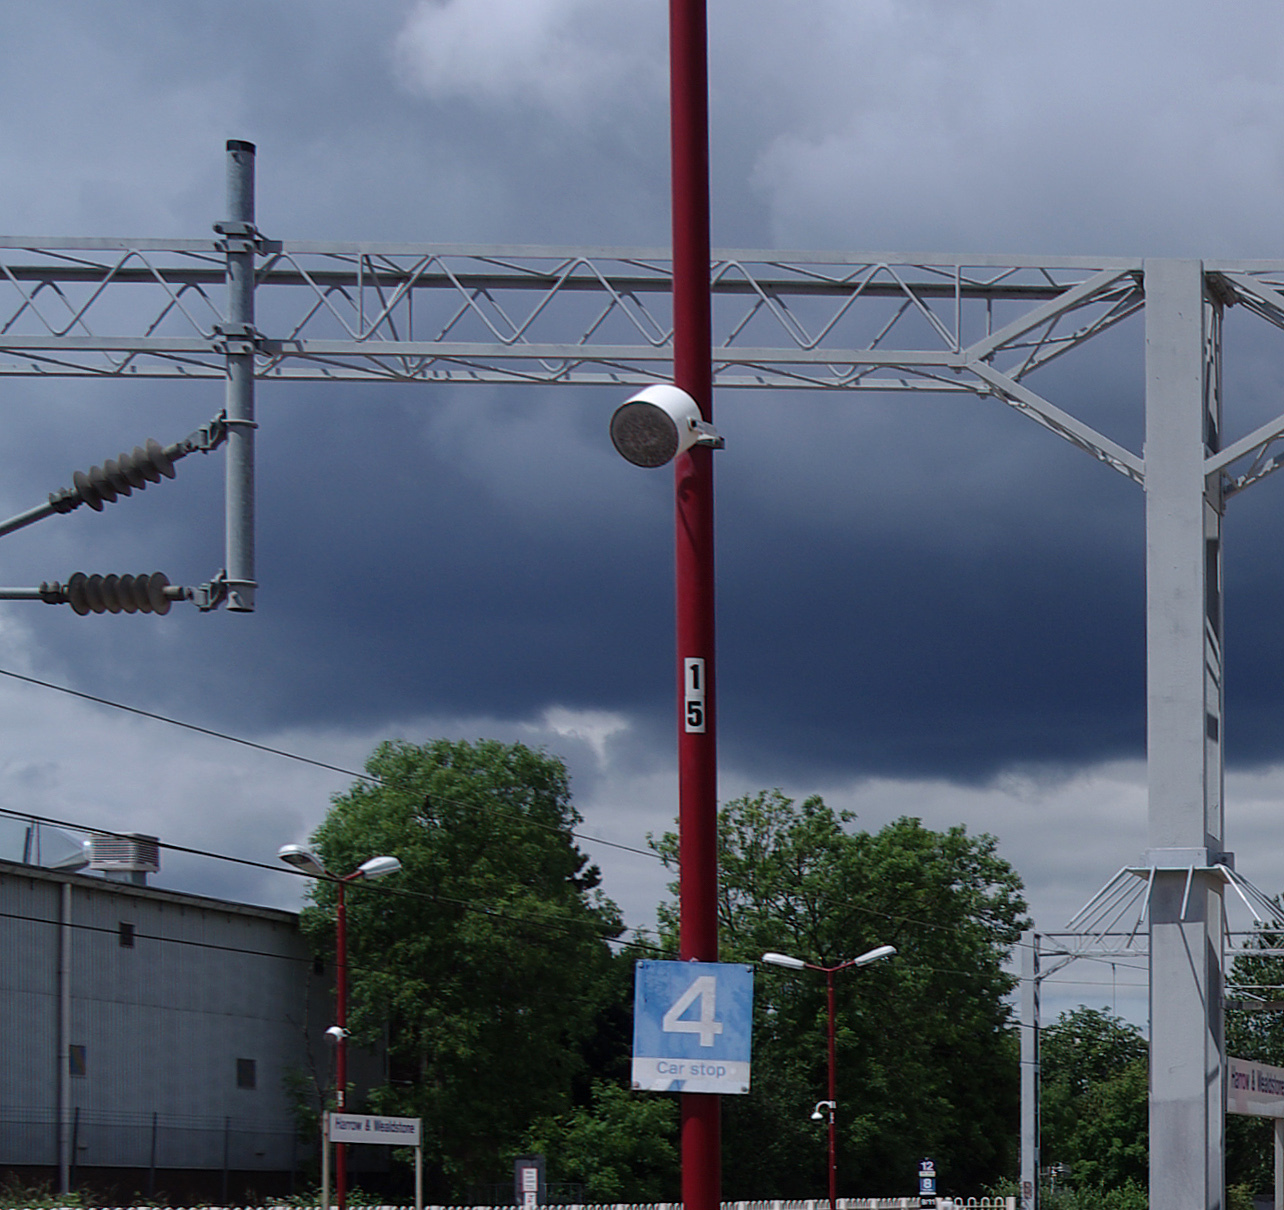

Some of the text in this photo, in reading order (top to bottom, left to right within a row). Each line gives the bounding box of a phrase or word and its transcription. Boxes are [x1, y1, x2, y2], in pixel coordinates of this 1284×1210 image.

[662, 976, 723, 1047] 4
[657, 1061, 726, 1078] Car stop
[920, 1161, 934, 1171] 12
[923, 1178, 932, 1189] 8
